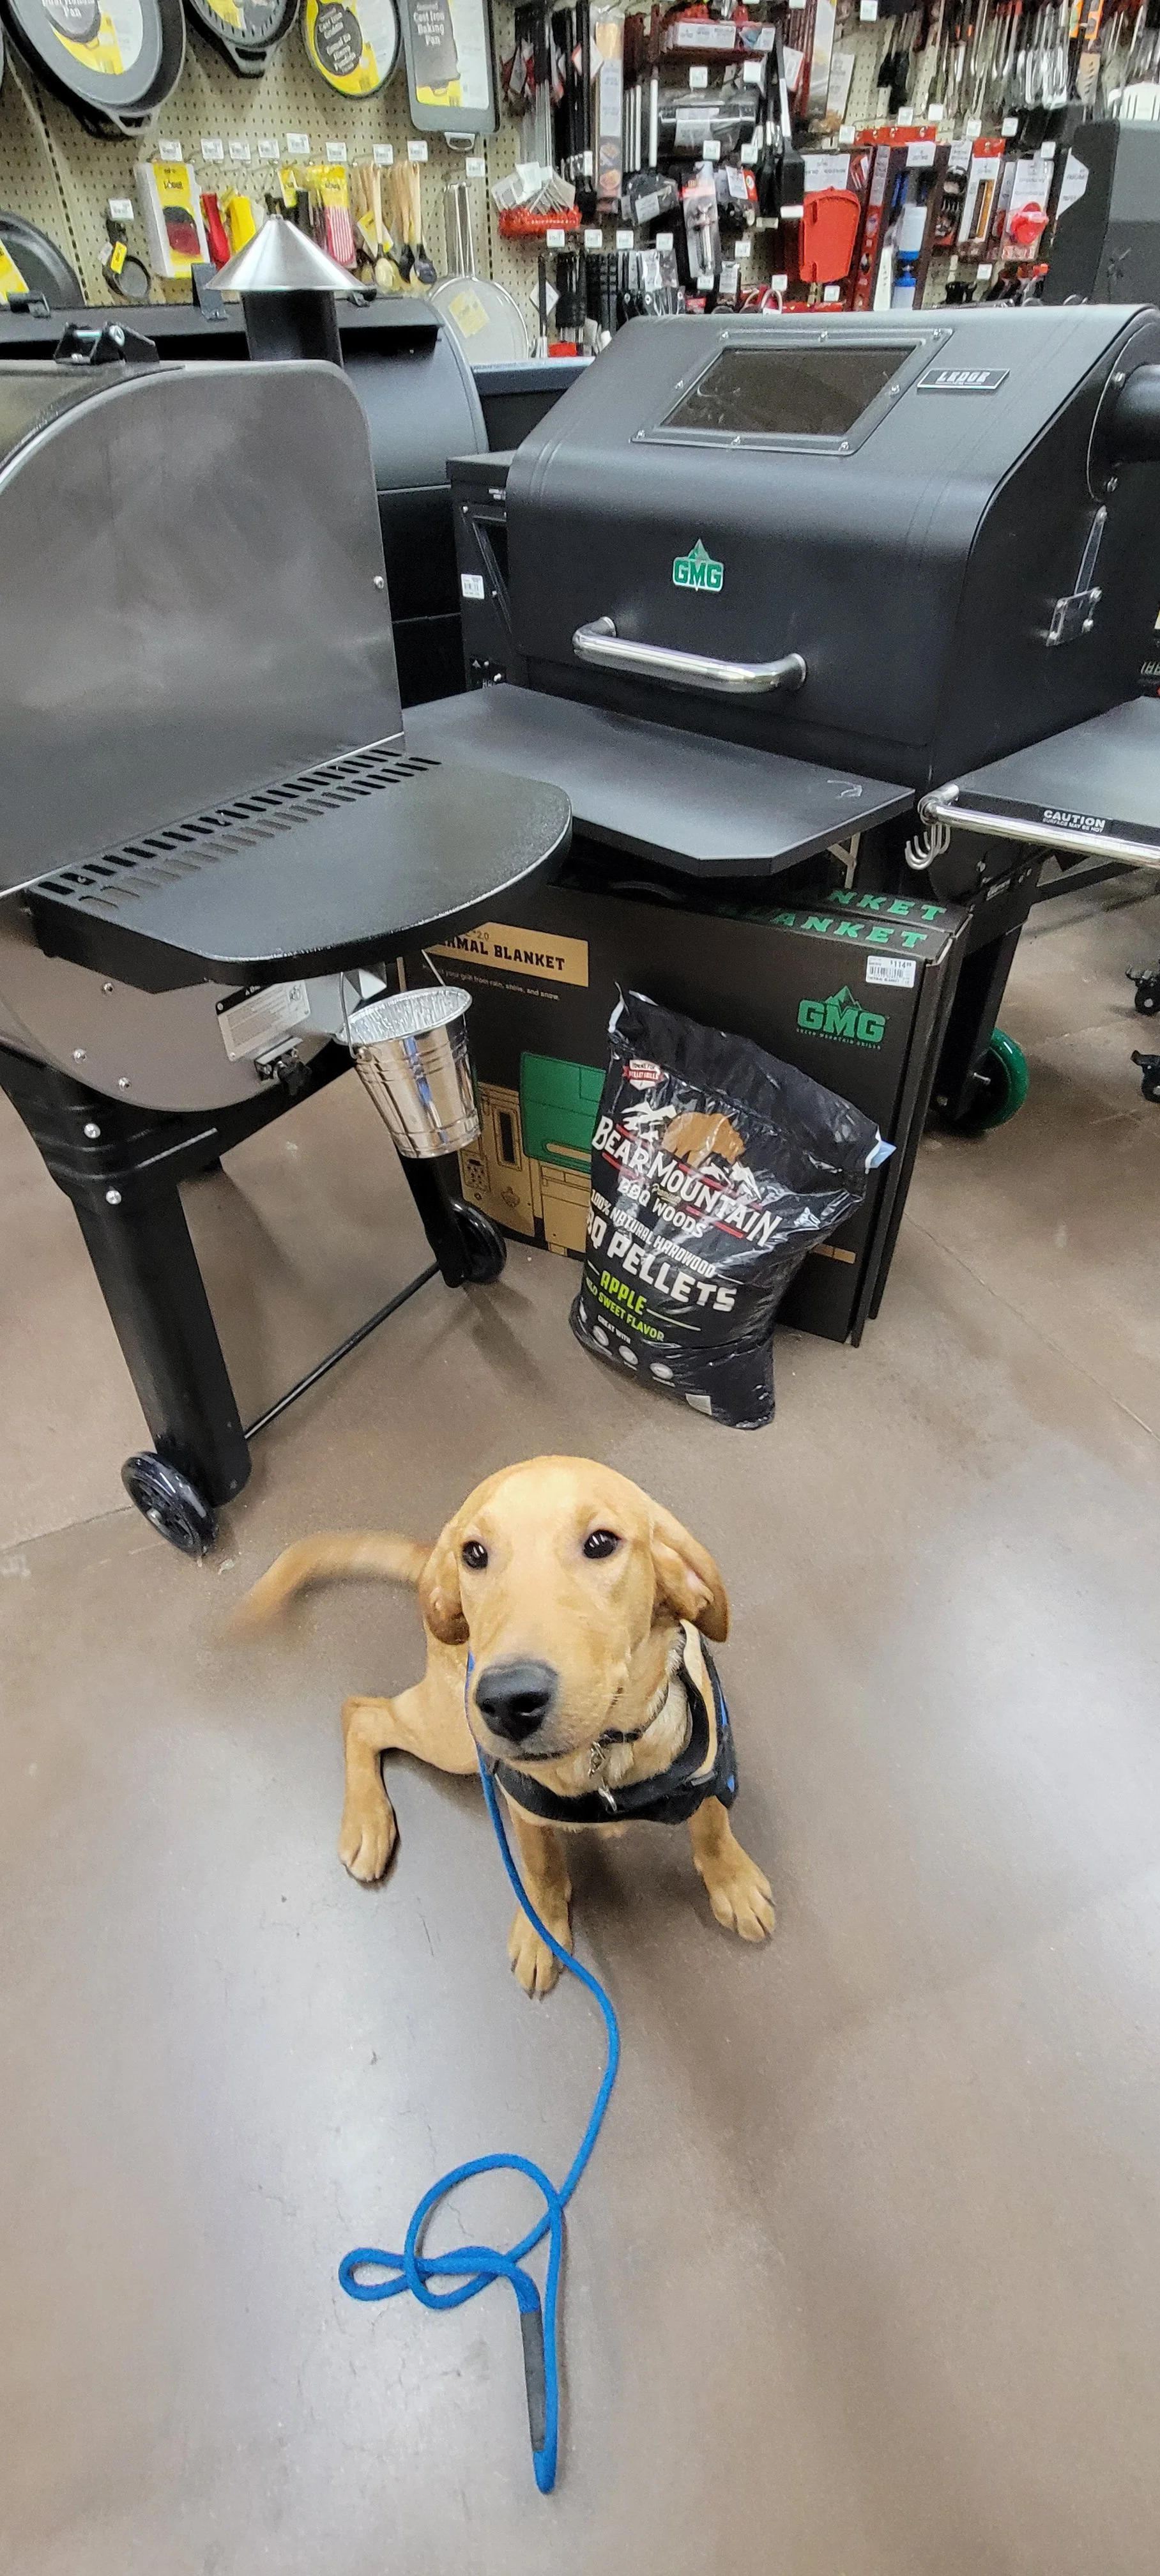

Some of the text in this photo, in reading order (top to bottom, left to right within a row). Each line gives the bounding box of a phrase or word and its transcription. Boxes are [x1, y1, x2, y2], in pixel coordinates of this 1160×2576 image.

[674, 559, 722, 589] GMG
[1042, 817, 1069, 827] SURFACE
[1043, 809, 1106, 828] CAUTION
[828, 890, 947, 921] NKET
[771, 912, 927, 948] ANKET
[494, 944, 565, 970] BLANKET
[797, 999, 886, 1043] GMG
[591, 1116, 783, 1247] BEAR MOUNTAIN
[617, 1177, 707, 1238] BBQ WOODS
[591, 1188, 715, 1278] 100% NATURAL HARDWOOD
[600, 1270, 647, 1315] APPLE
[607, 1230, 737, 1312] PELLETS
[598, 1291, 626, 1320] SWEET
[626, 1314, 665, 1342] FLAVOR
